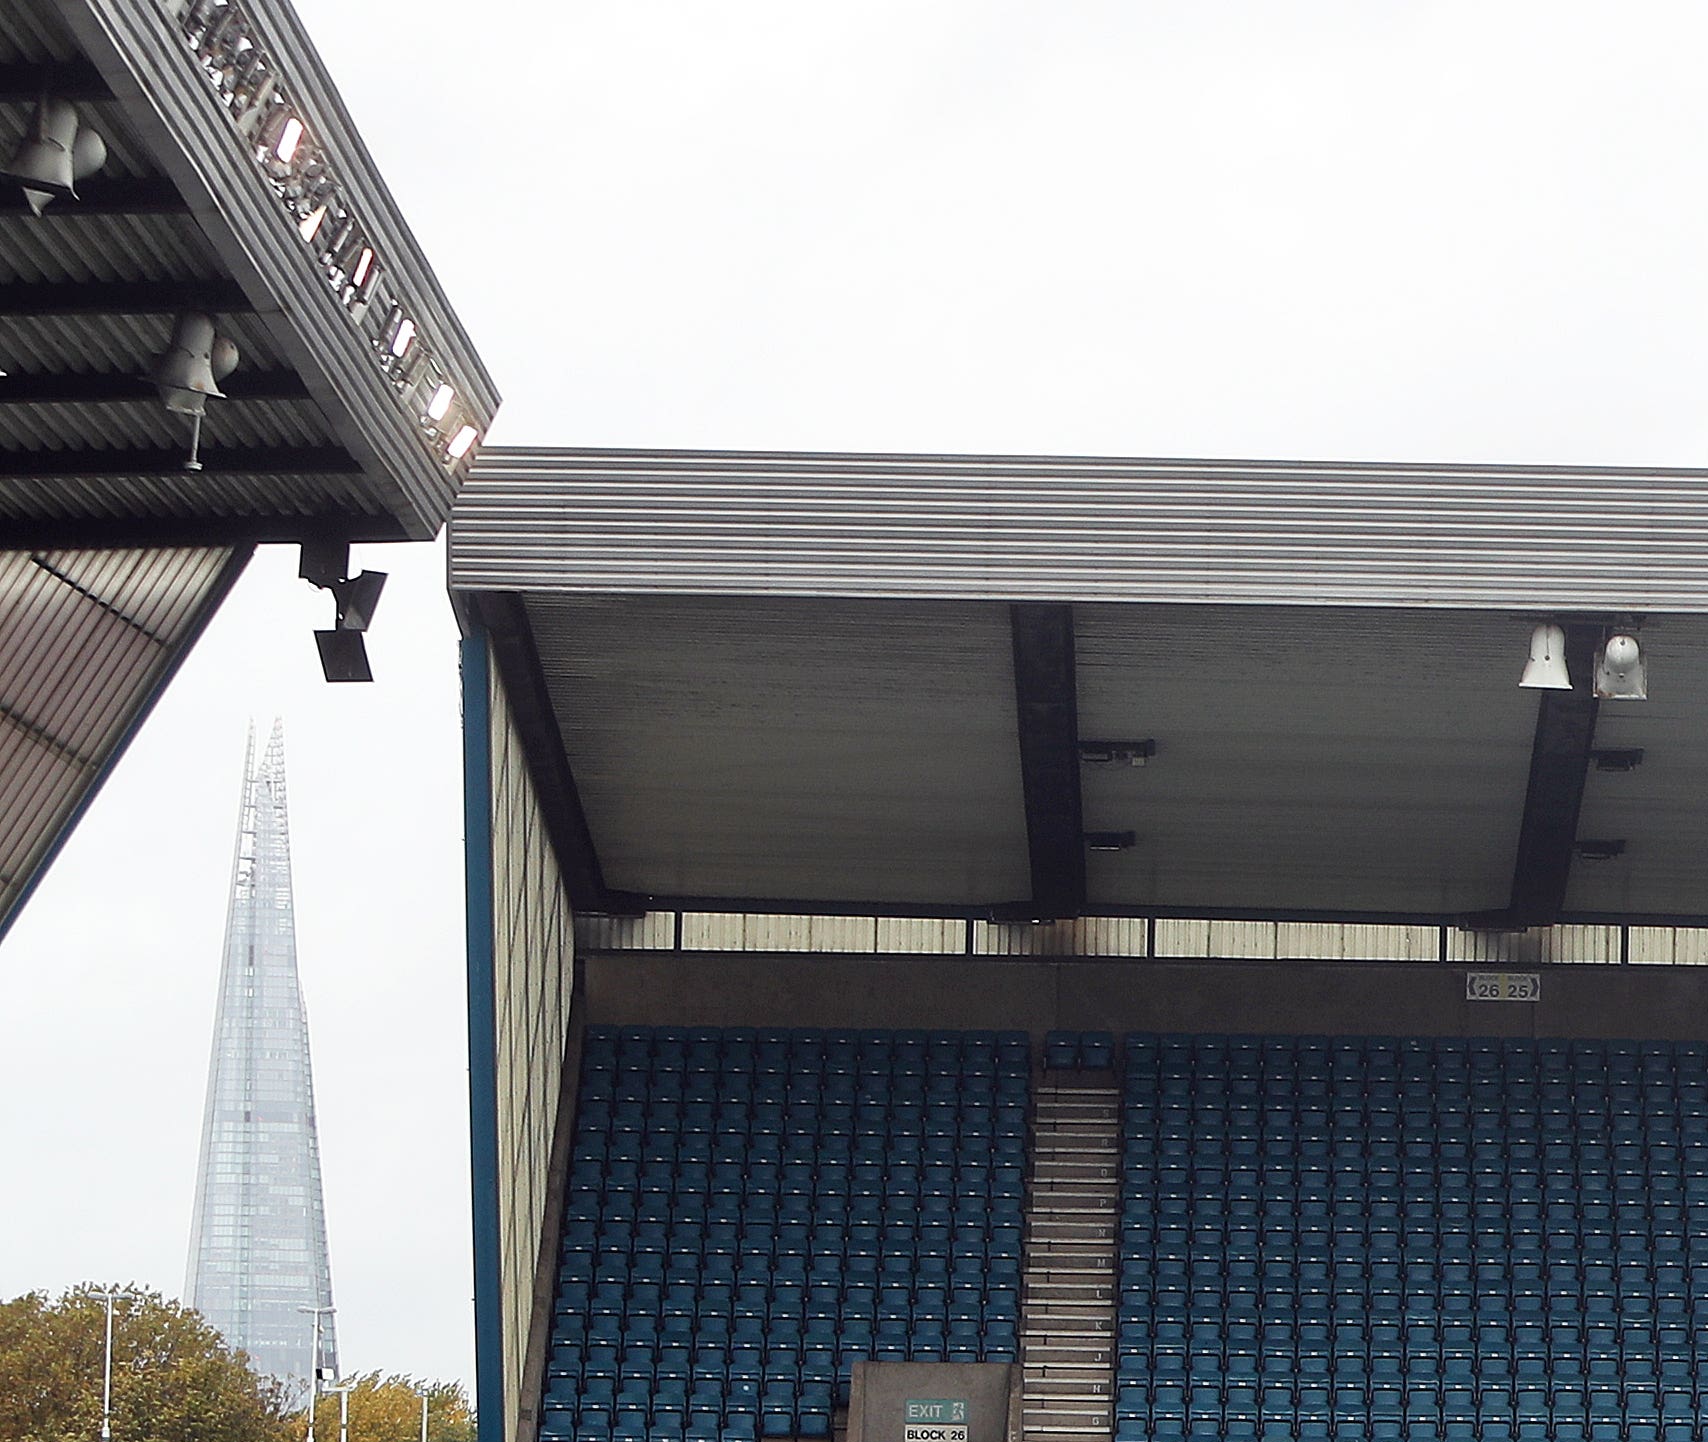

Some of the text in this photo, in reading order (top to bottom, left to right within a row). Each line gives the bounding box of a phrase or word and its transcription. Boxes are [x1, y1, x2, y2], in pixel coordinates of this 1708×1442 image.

[1479, 984, 1529, 998] 26 25
[908, 1405, 944, 1418] EXIT
[907, 1430, 966, 1441] BLOCK 26
